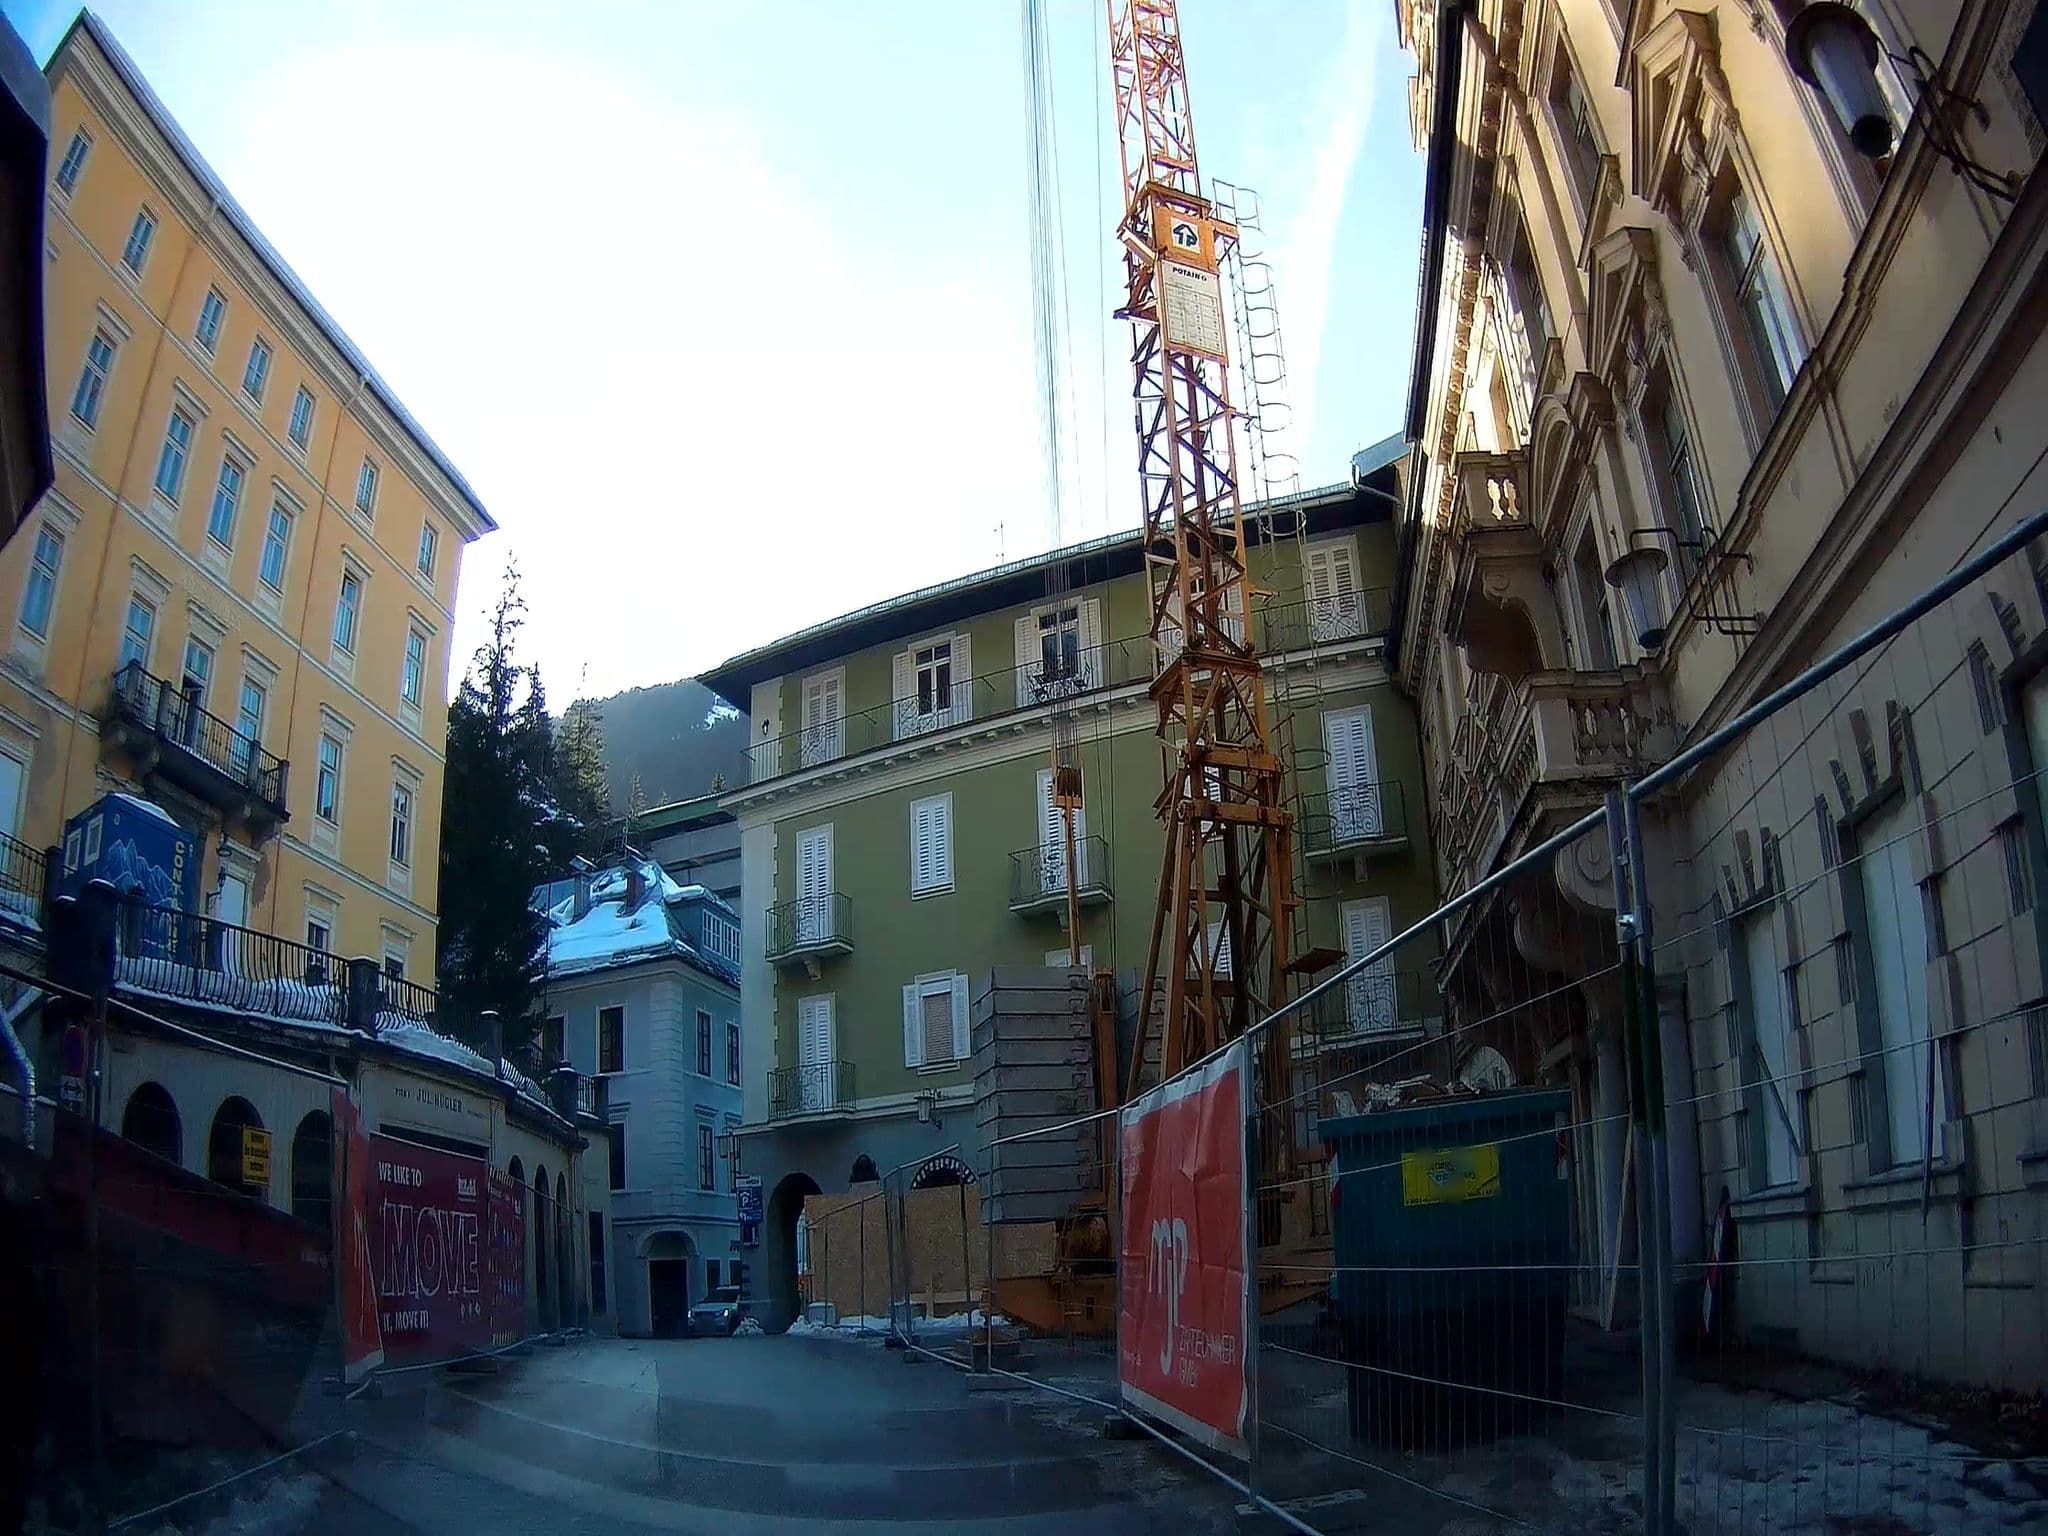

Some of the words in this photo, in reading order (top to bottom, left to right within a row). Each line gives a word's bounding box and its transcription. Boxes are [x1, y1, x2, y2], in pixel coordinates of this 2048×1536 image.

[378, 1160, 392, 1183] WE
[393, 1165, 410, 1187] LIKE
[411, 1168, 423, 1187] TO
[380, 1202, 480, 1299] MOVE
[395, 1310, 419, 1332] MOVE
